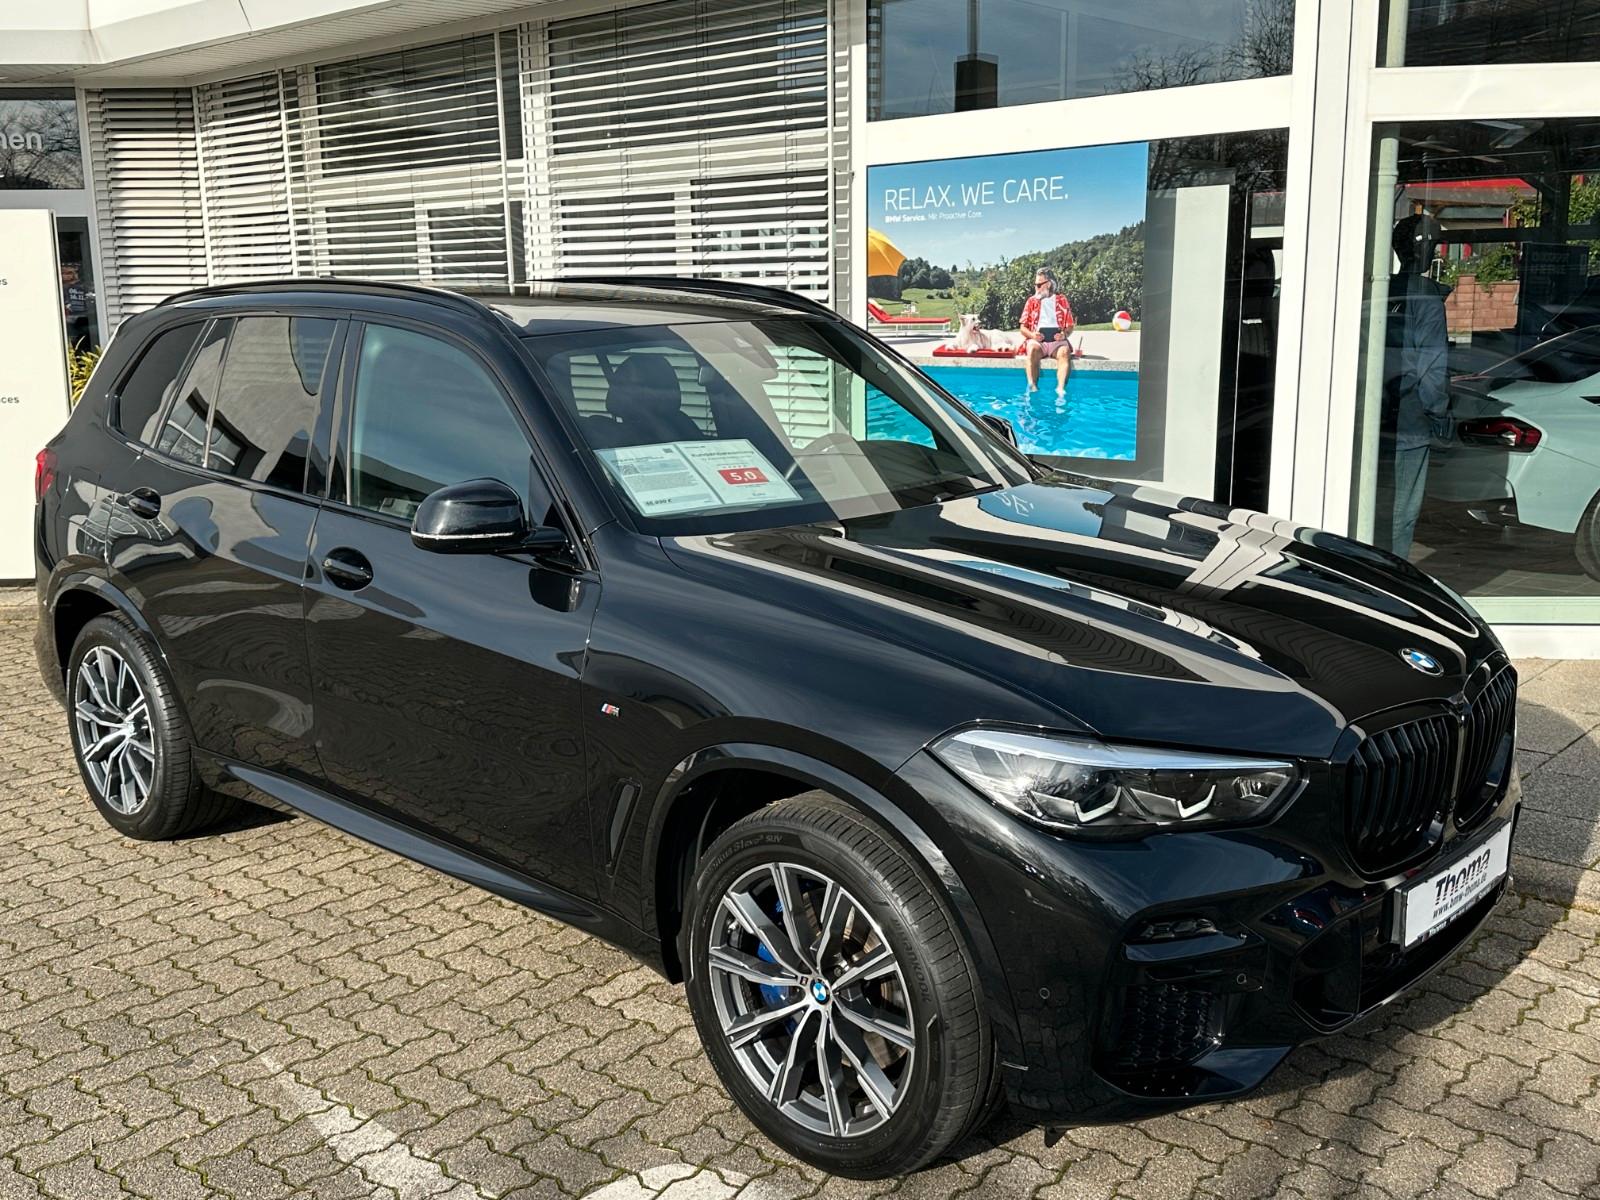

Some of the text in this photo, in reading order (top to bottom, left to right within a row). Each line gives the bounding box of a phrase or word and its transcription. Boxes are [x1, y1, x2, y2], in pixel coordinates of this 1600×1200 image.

[885, 176, 1069, 211] RELAX. WE CARE.
[730, 471, 757, 482] 5,0
[1434, 848, 1491, 906] Thoma
